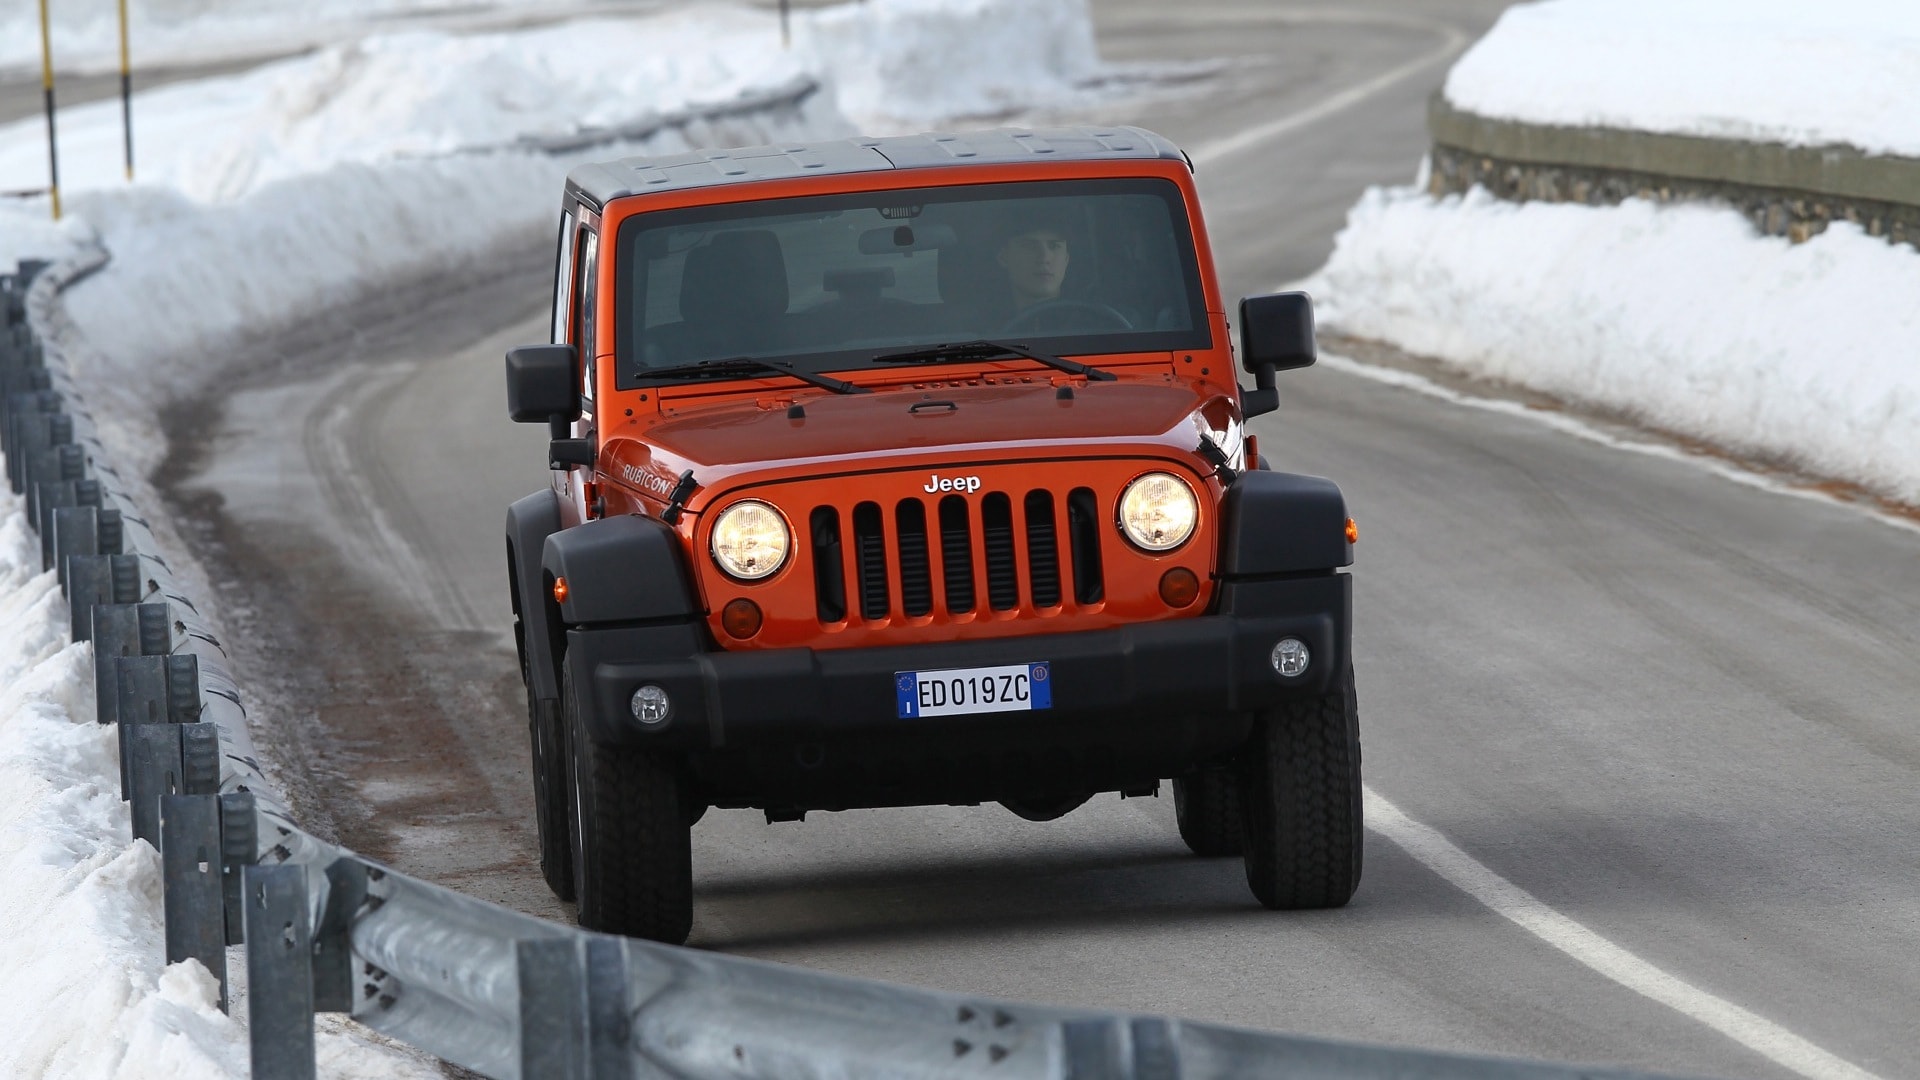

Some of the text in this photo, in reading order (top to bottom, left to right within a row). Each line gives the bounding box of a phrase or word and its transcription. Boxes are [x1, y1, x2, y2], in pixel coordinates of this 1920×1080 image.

[623, 464, 671, 494] RUBICON
[924, 474, 981, 493] Jeep
[918, 674, 1029, 708] ED019ZC
